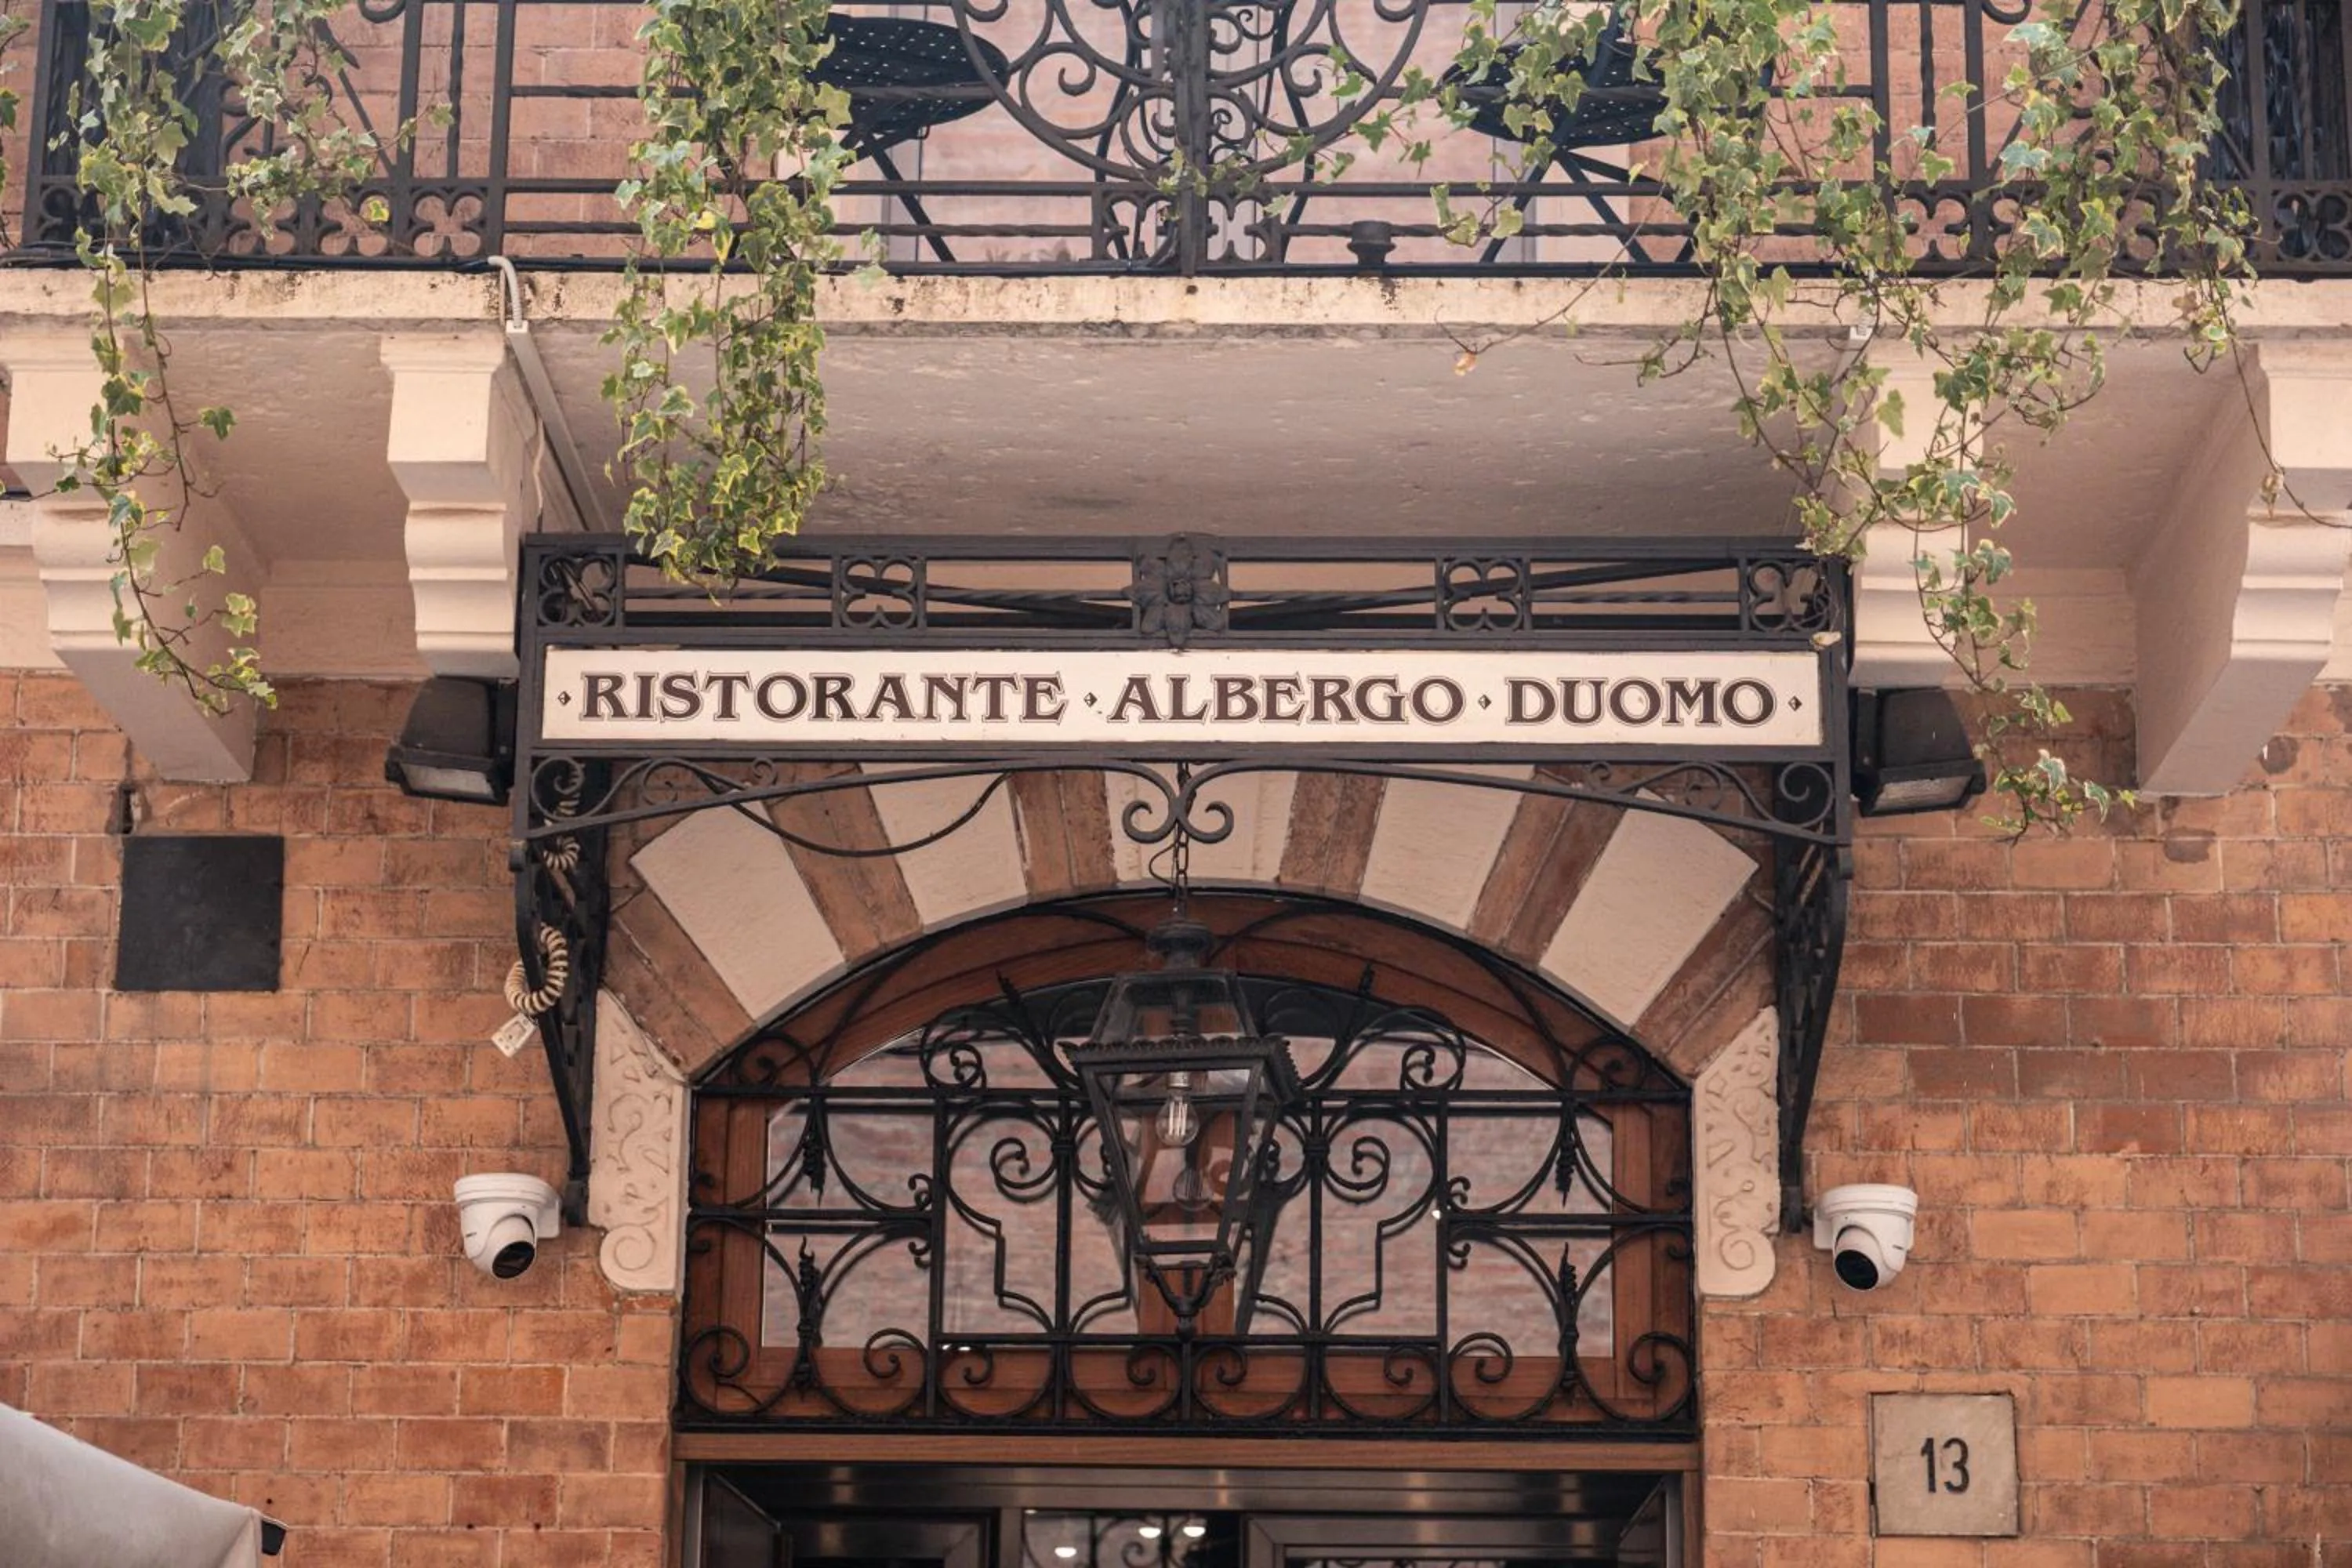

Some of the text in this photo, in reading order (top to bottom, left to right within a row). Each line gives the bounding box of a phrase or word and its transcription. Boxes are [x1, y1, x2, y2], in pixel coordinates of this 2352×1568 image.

[579, 670, 1777, 726] RISTORANTE ALBERGO DUOMO
[1921, 1438, 1969, 1494] 13
